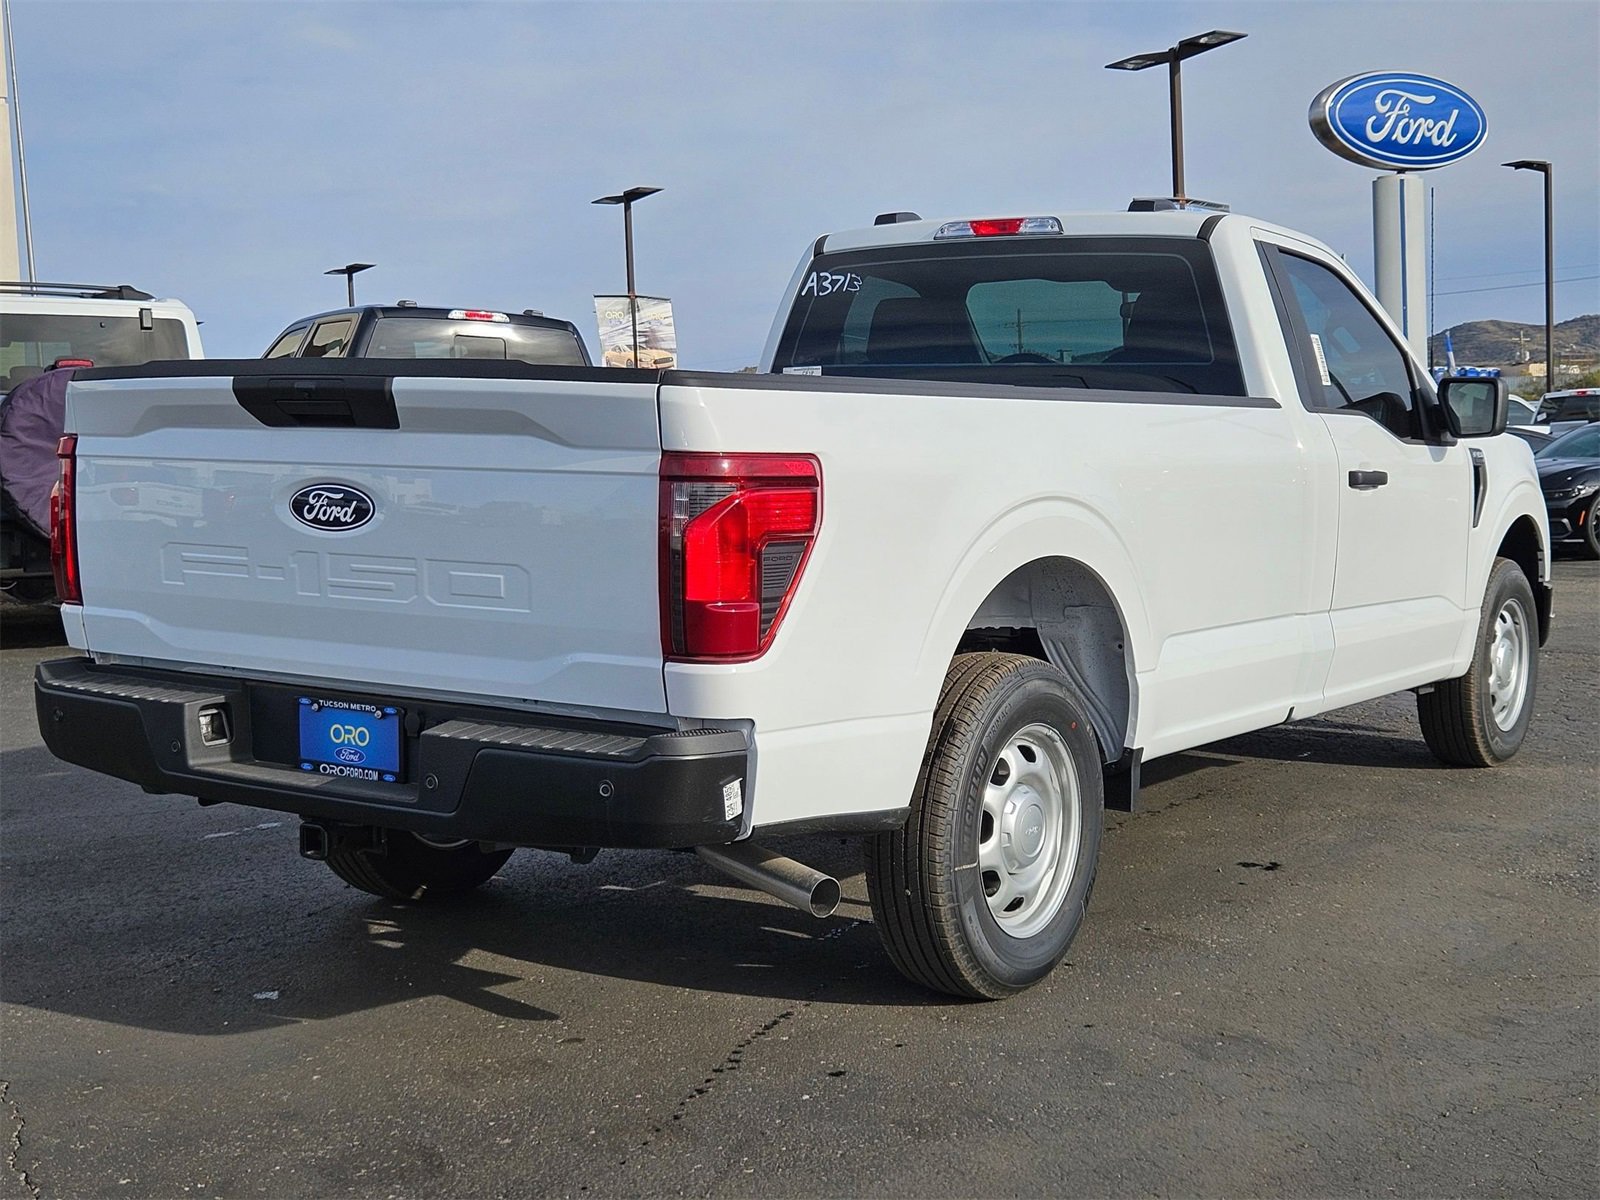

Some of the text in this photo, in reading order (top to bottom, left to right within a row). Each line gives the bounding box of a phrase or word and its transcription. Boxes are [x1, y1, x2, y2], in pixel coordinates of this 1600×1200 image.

[1366, 89, 1459, 147] Ford
[801, 271, 863, 296] A3713
[303, 490, 355, 523] Ford
[160, 542, 530, 613] F-150
[319, 699, 349, 709] TUCSON
[350, 703, 376, 712] METRO
[330, 724, 369, 747] ORO
[340, 749, 360, 762] Ford
[320, 763, 378, 781] OROFORD.COM
